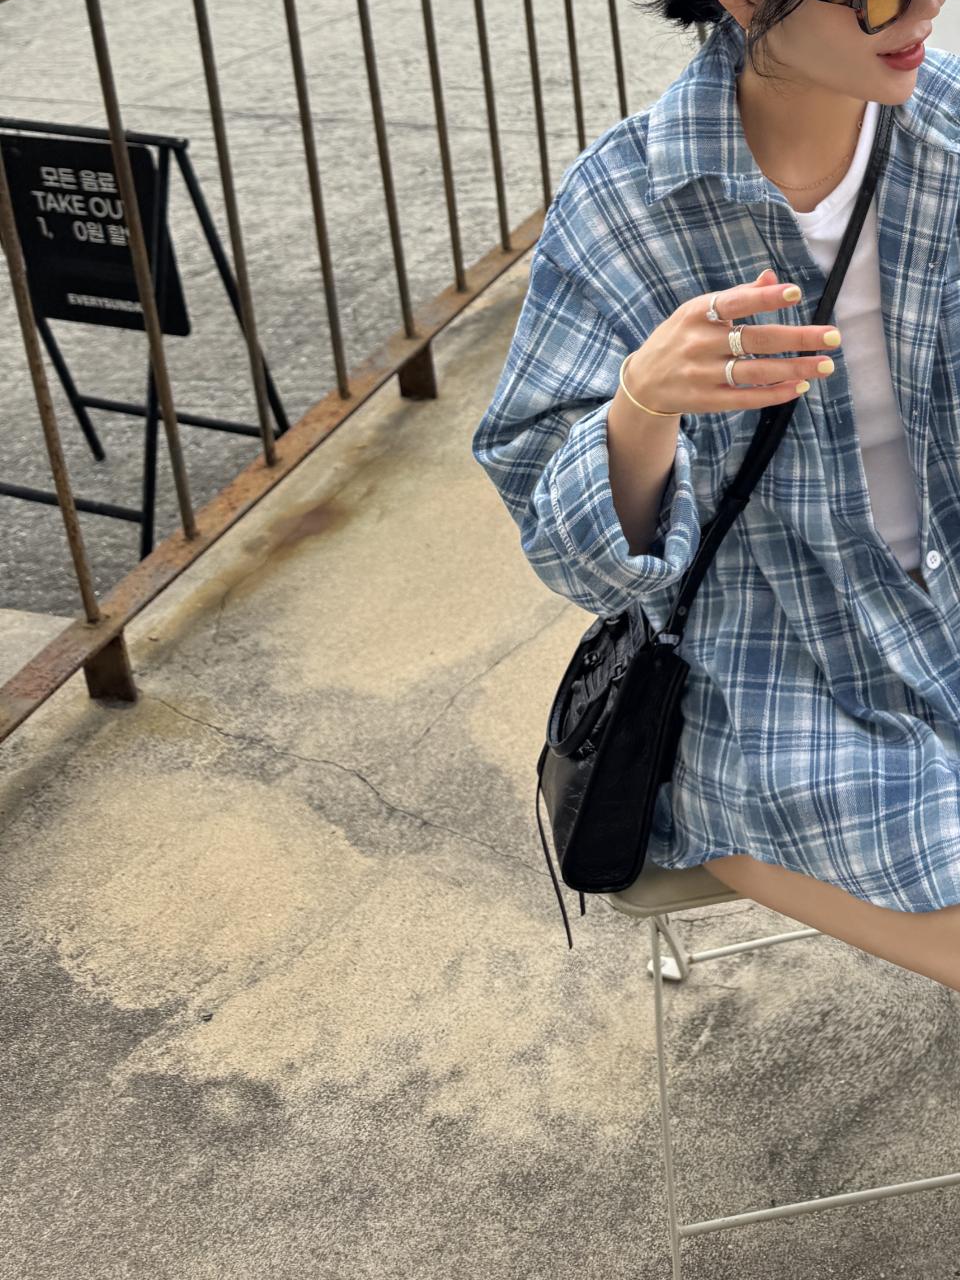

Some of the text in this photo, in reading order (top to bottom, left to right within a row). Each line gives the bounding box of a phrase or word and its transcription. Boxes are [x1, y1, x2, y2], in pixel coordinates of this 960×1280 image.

[40, 165, 118, 193] 모든 음료
[30, 189, 125, 220] TAKE OU
[106, 223, 130, 247] 할
